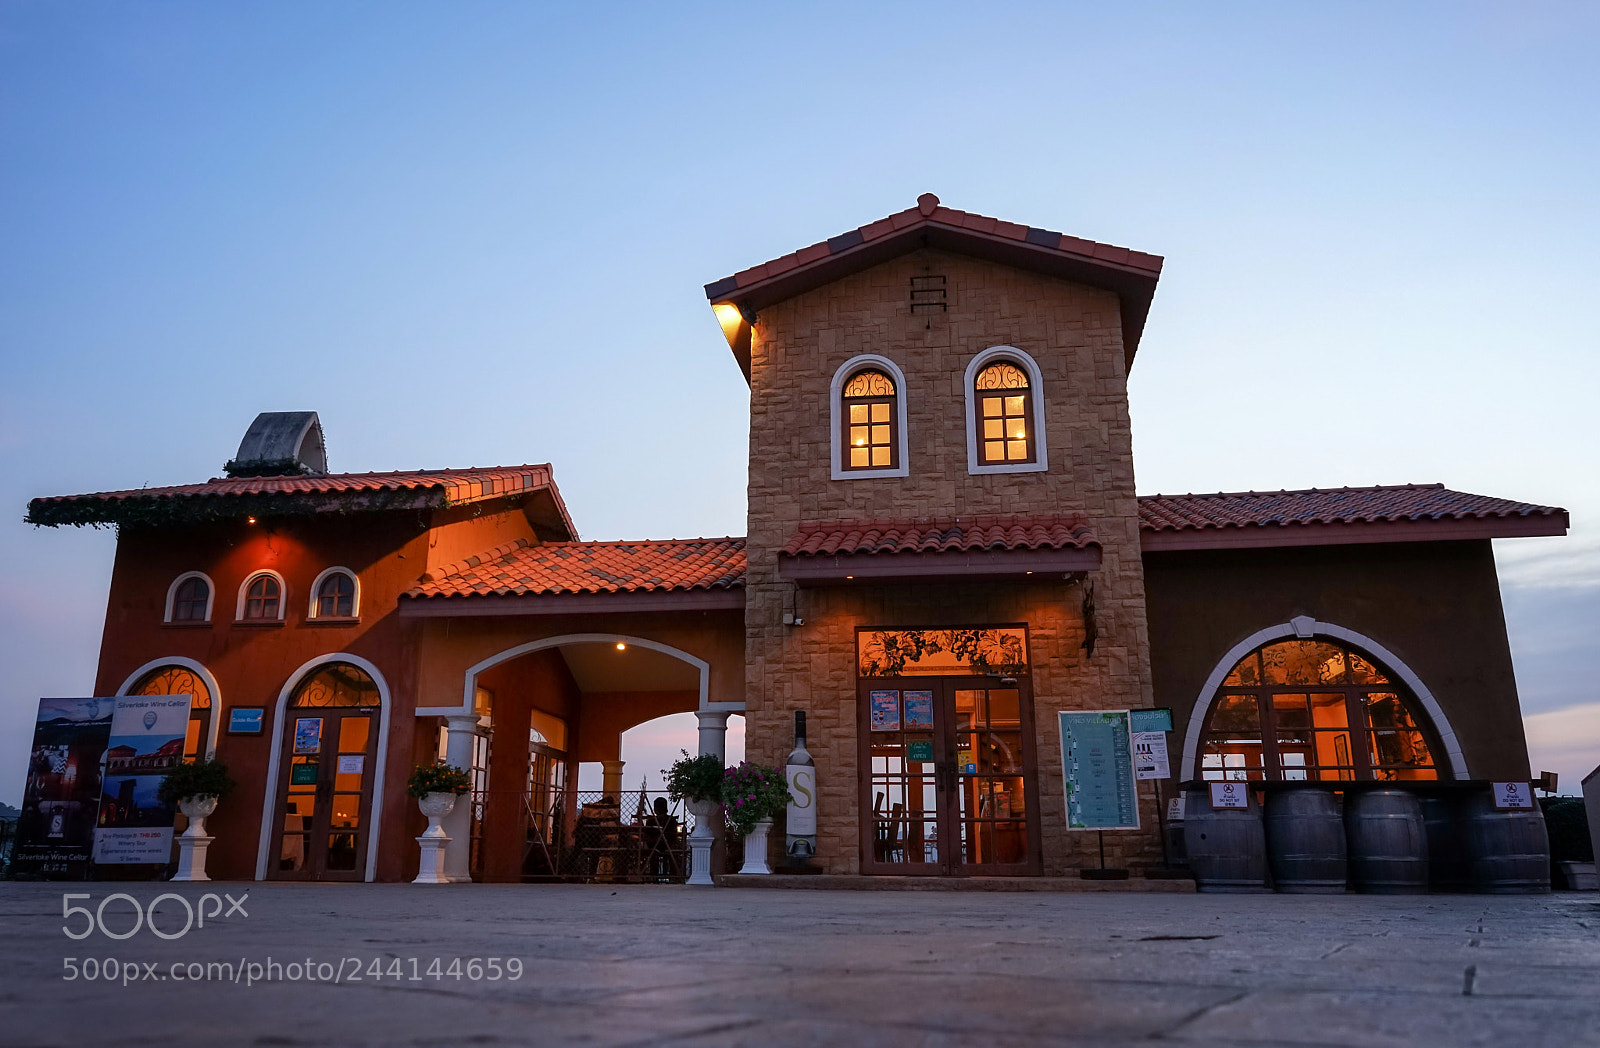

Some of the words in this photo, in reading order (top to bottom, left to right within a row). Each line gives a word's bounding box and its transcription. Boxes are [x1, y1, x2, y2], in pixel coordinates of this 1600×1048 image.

[792, 771, 811, 809] S
[17, 853, 49, 861] Silverlake
[50, 853, 68, 861] Wine
[68, 853, 88, 861] Cellar
